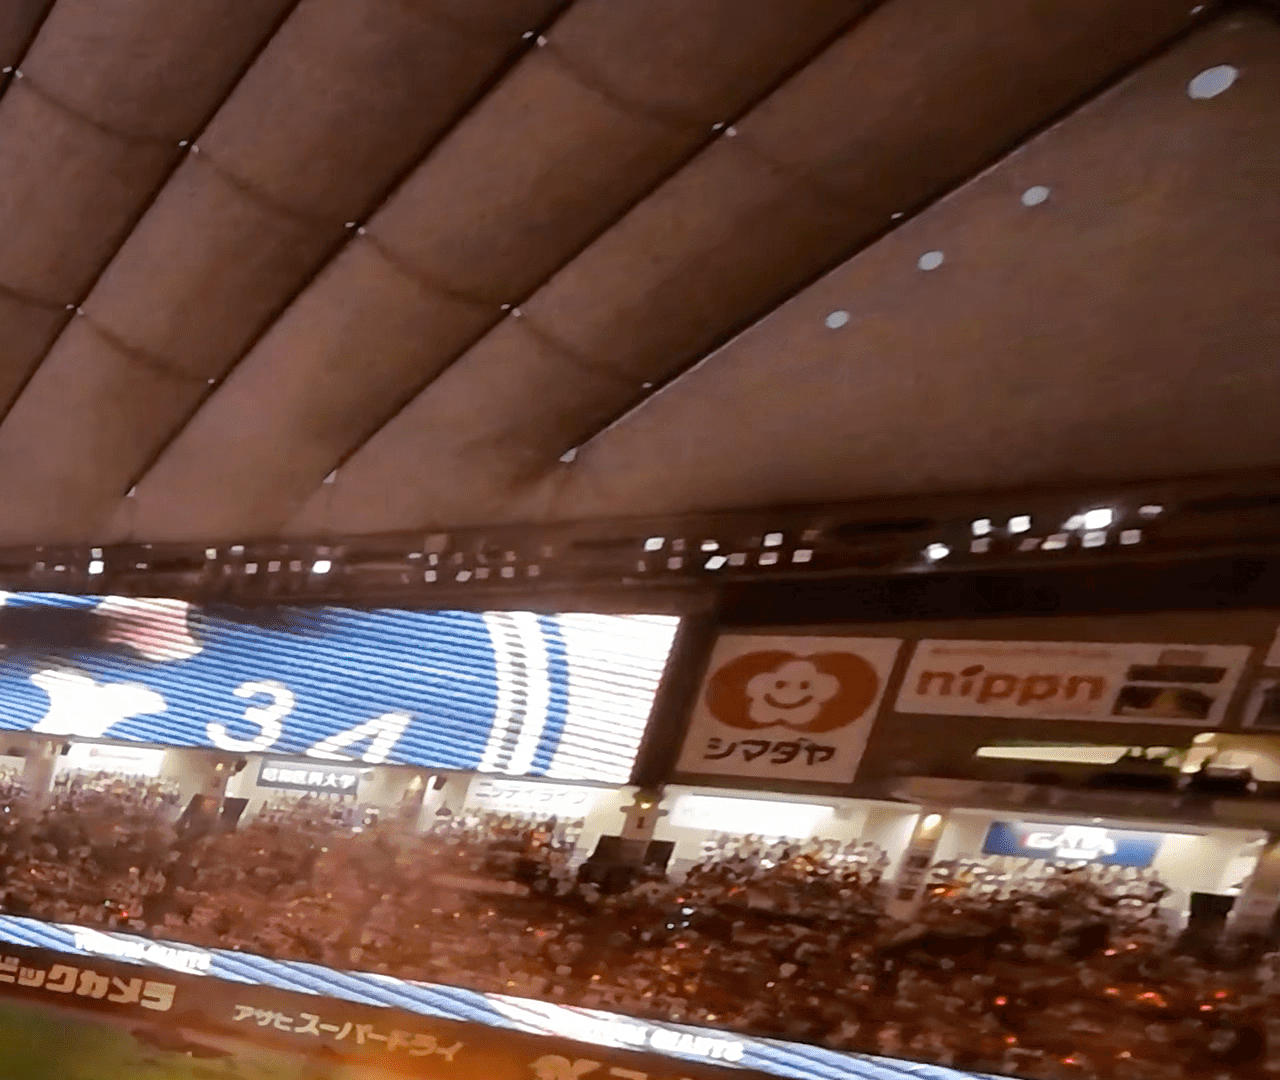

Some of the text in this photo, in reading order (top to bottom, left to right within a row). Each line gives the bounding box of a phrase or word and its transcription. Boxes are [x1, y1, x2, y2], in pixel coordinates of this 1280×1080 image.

[915, 663, 1107, 708] nippn
[703, 735, 837, 766] シマダヤ
